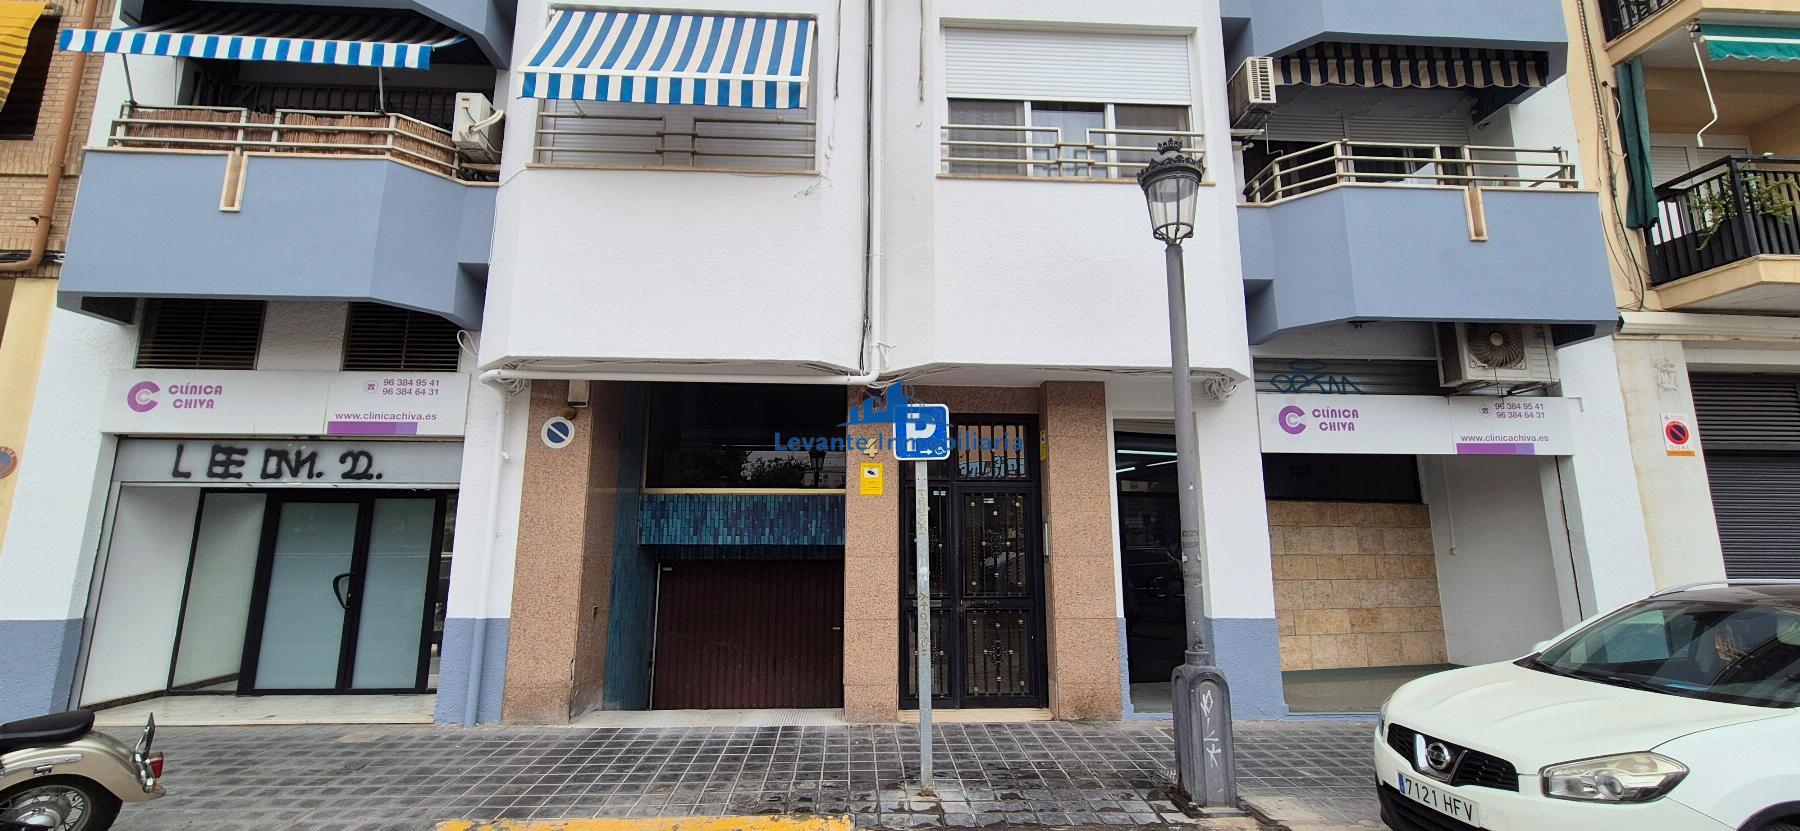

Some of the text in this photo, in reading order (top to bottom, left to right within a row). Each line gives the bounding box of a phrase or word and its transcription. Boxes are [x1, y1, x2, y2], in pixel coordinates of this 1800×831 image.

[168, 382, 222, 395] CLÍNICA
[415, 388, 426, 396] 64
[428, 388, 439, 396] 31
[173, 399, 214, 409] CHIVA
[335, 412, 437, 420] www.clinicachiva.es
[1312, 407, 1359, 419] CLÍNICA
[1319, 421, 1355, 431] CHIVA
[906, 412, 937, 452] P
[1460, 434, 1549, 442] www.clinicachiva.es
[1405, 778, 1472, 821] 7121 HFV
